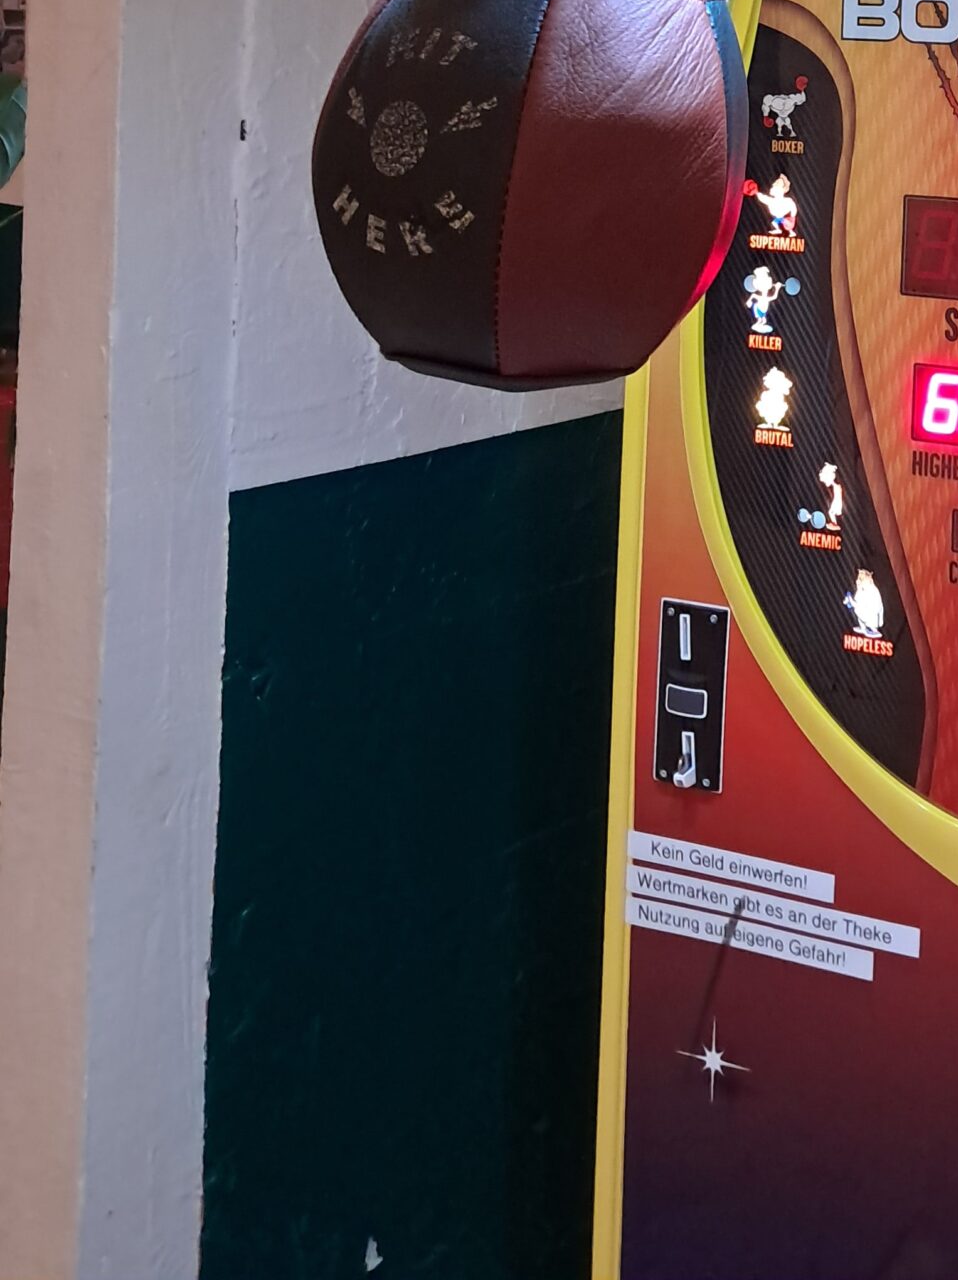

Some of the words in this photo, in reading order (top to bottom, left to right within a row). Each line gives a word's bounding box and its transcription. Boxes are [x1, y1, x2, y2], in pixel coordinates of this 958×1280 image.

[771, 140, 804, 155] BOXER
[749, 234, 805, 253] SUPERMAN
[748, 334, 782, 351] KILLER
[754, 429, 794, 448] BRUTAL
[800, 531, 842, 551] ANEMIC
[844, 634, 894, 657] HOPELESS
[650, 840, 684, 863] Kein
[689, 849, 724, 871] Geld
[729, 860, 808, 890] einwerfen!
[637, 872, 728, 906] Wertmarken
[733, 895, 761, 914] gibt
[765, 903, 784, 920] es
[788, 910, 807, 926] an
[812, 912, 837, 933] der
[843, 918, 892, 945] Theke
[638, 905, 700, 934] Nutzung
[733, 926, 784, 953] eigene
[789, 940, 846, 967] Gefahr!
